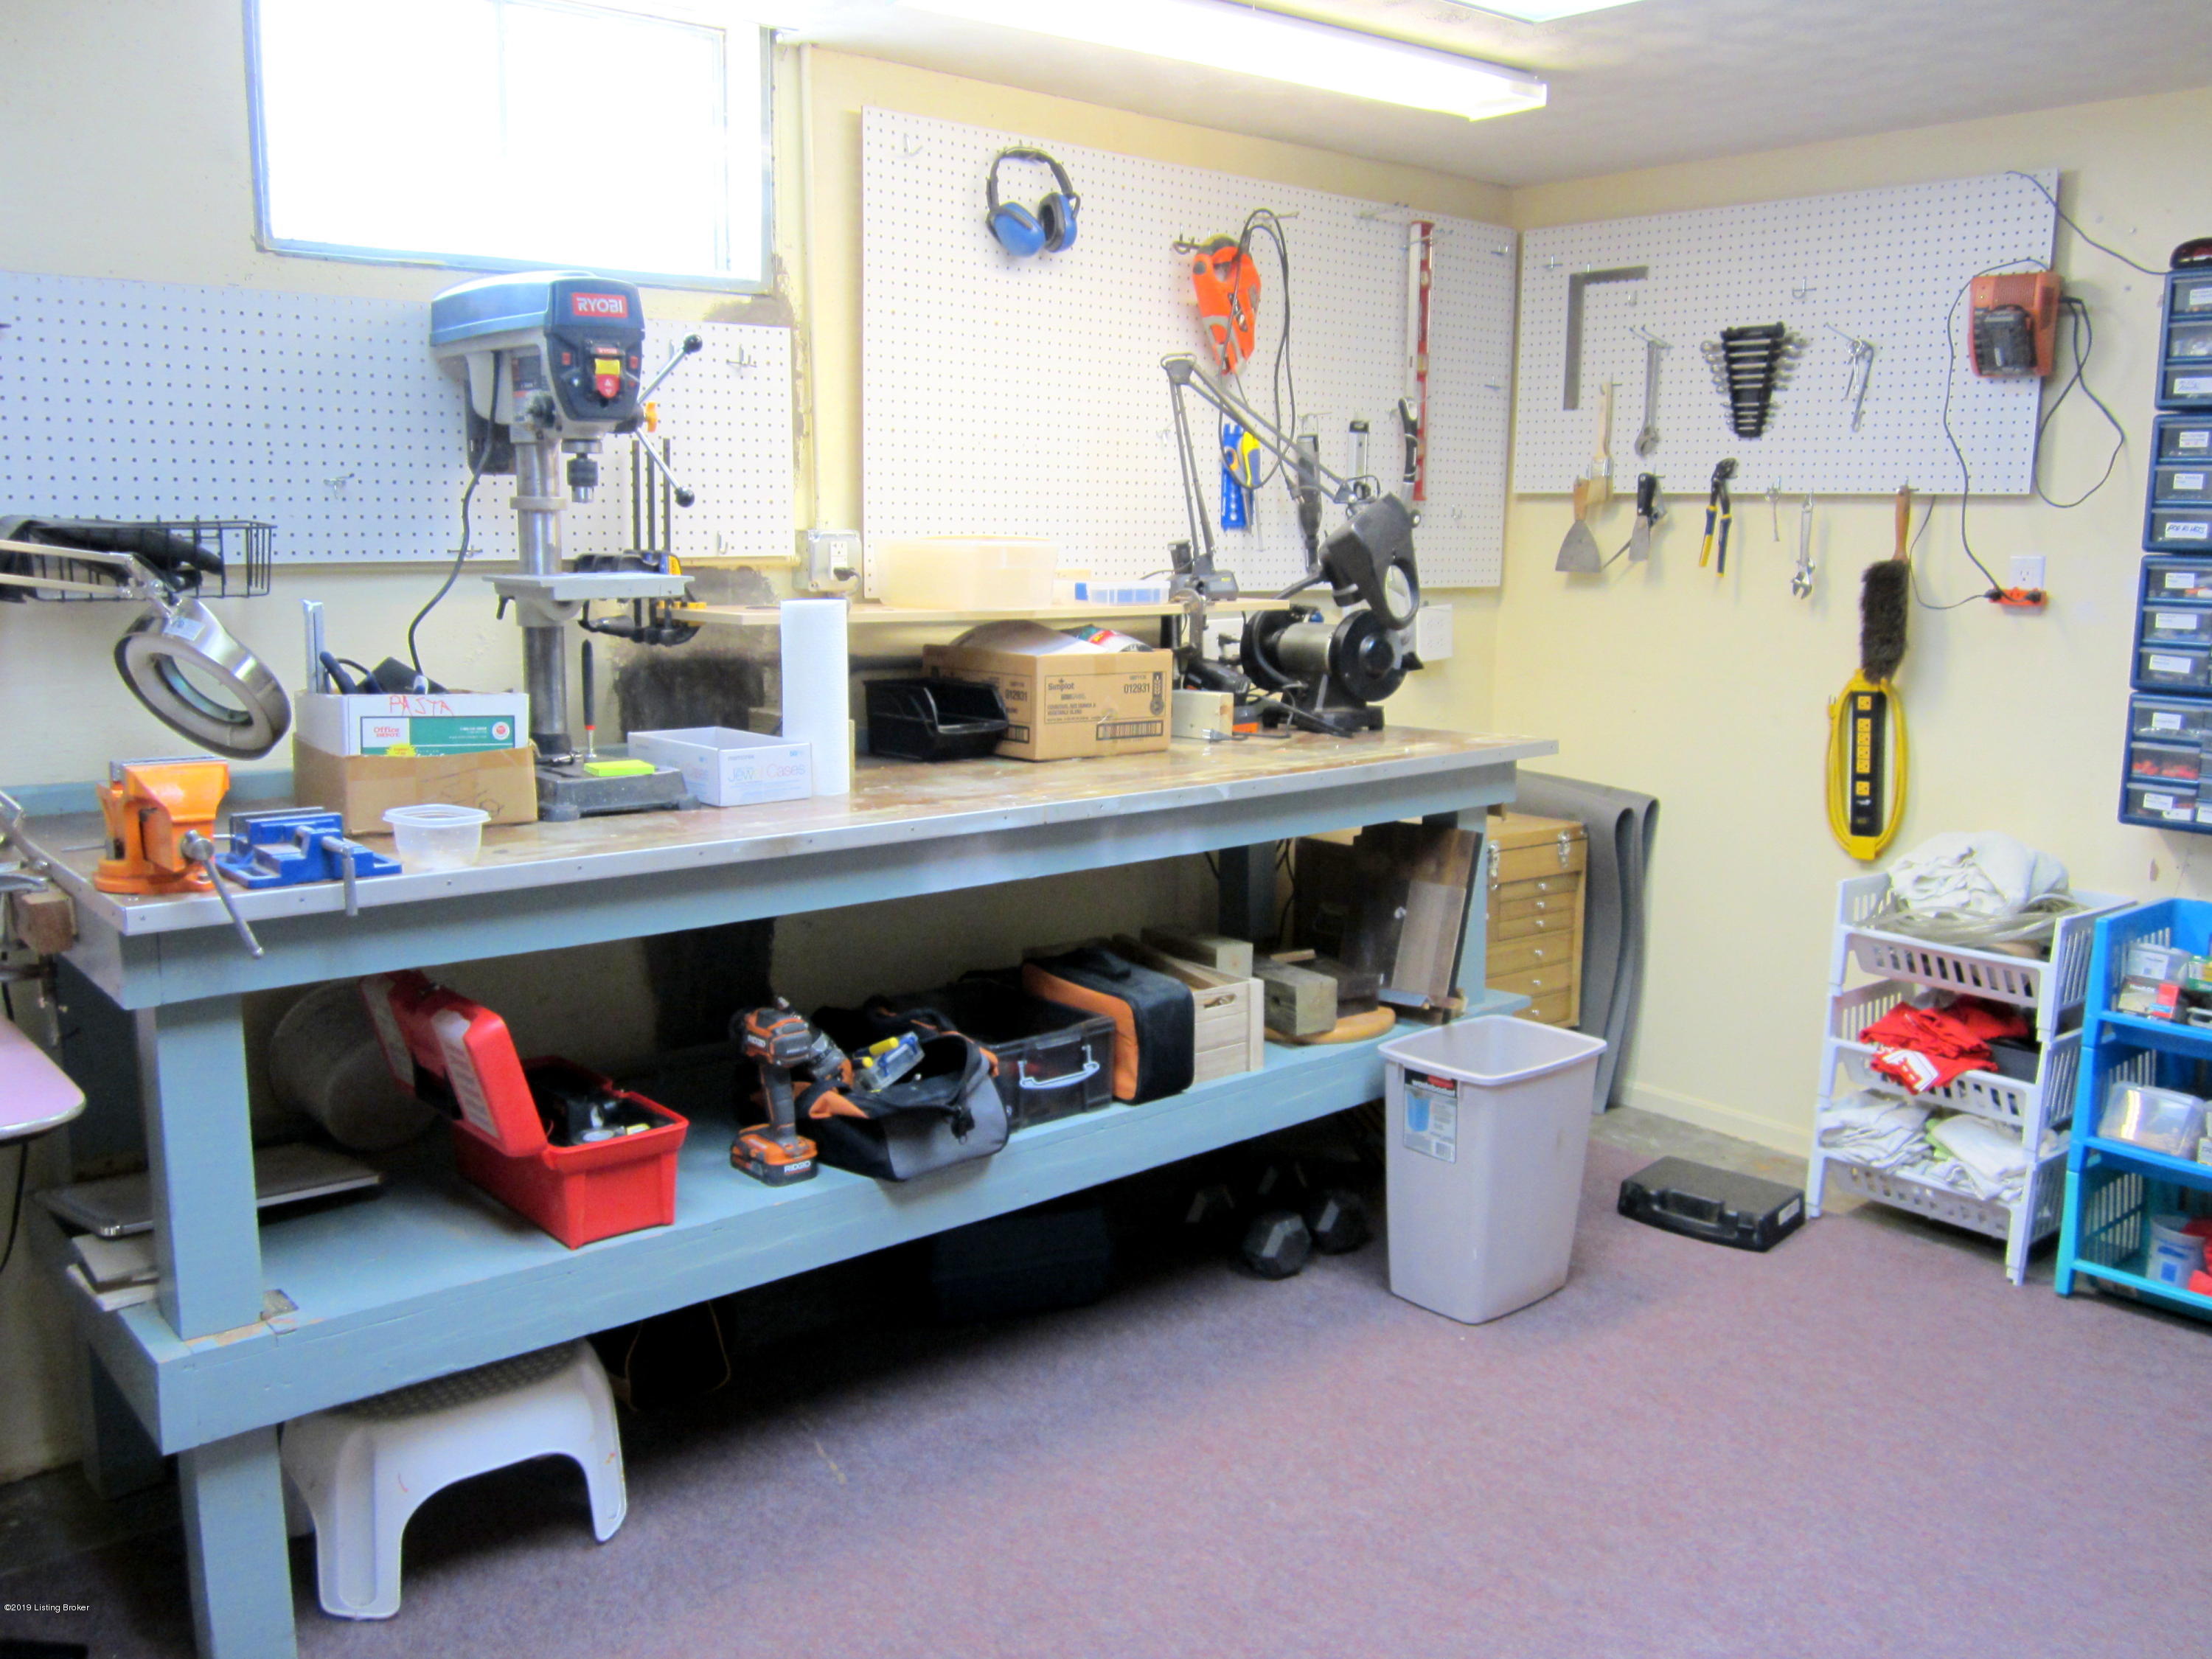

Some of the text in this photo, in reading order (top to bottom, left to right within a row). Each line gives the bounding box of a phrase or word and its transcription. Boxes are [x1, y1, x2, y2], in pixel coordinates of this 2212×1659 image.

[577, 297, 623, 313] RYOBI
[1048, 682, 1074, 692] Simplot
[1123, 684, 1150, 694] 012931
[389, 695, 454, 717] PASTA
[767, 763, 806, 779] Cases
[784, 1160, 811, 1173] RIDGID
